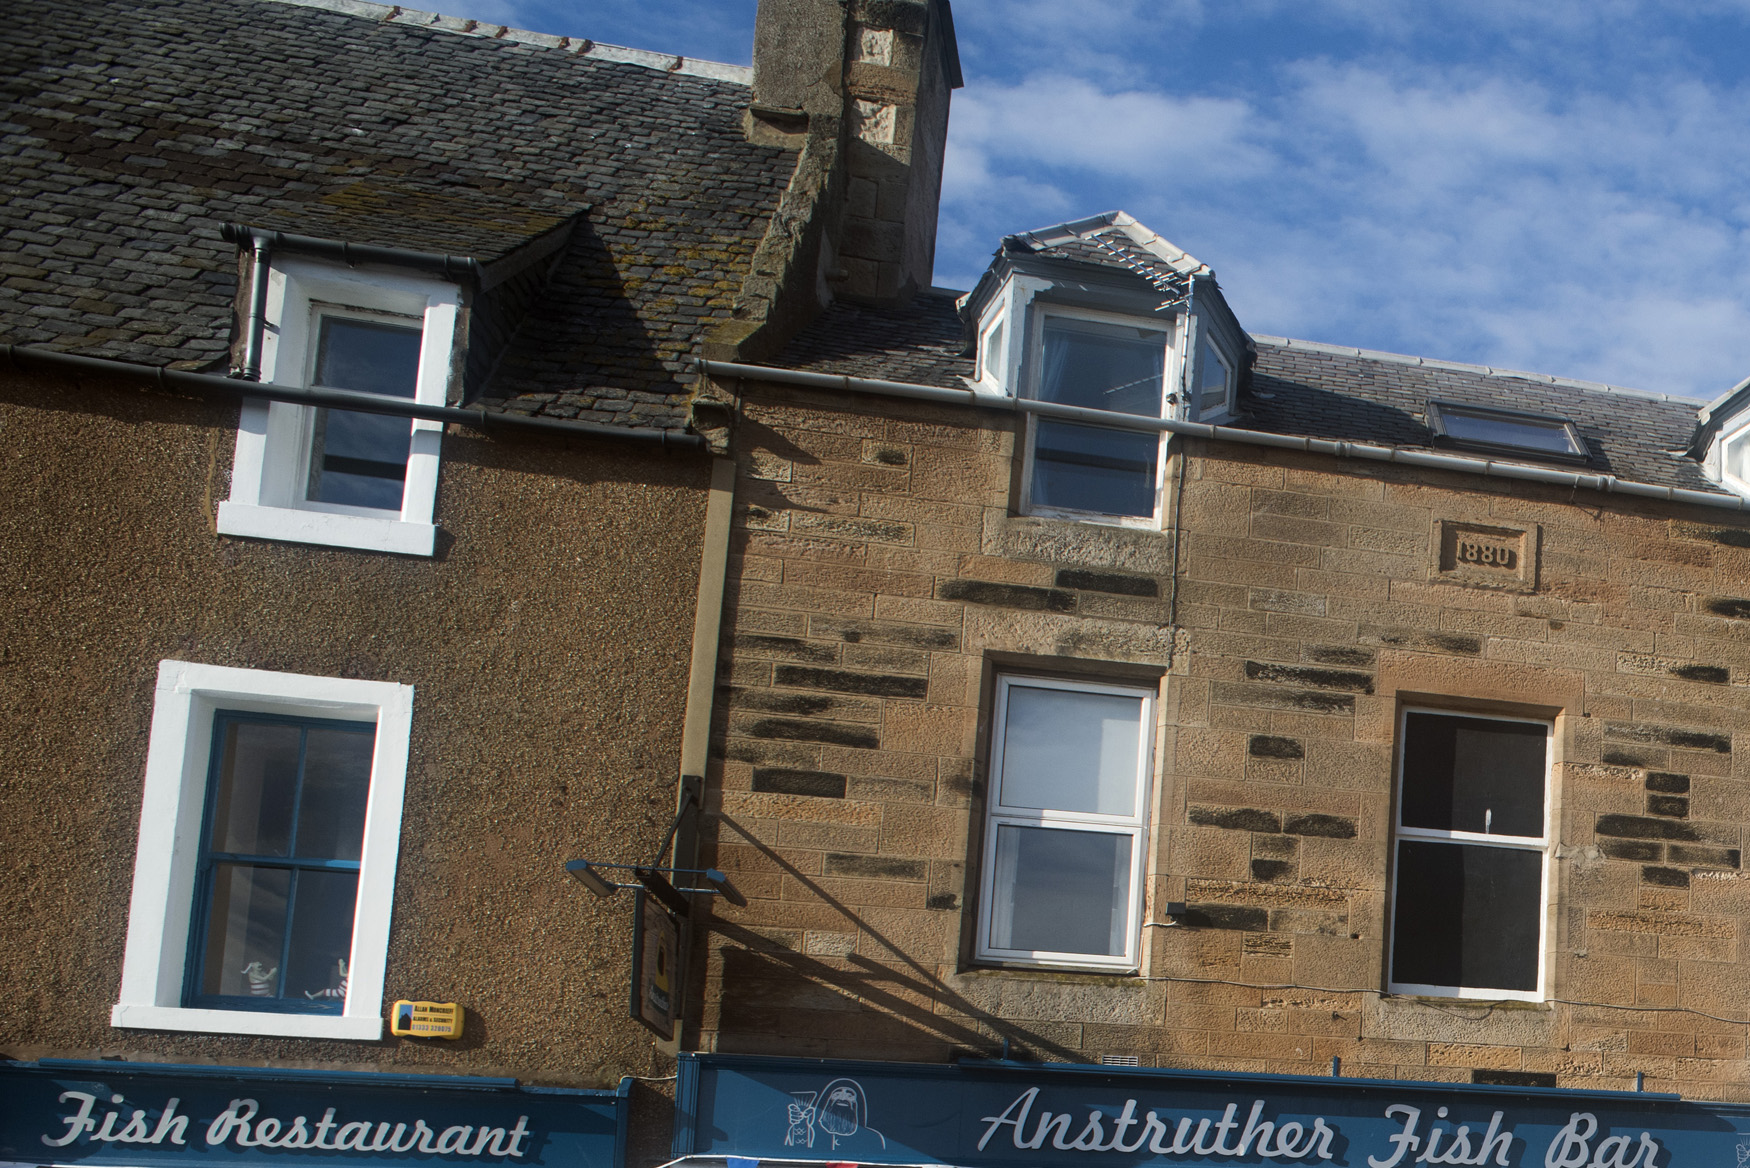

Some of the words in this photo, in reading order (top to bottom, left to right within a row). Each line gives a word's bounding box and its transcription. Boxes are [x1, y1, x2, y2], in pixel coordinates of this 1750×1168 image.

[1456, 539, 1509, 564] 1880
[41, 1091, 190, 1147] Fish
[206, 1098, 530, 1158] Restaurant
[977, 1086, 1334, 1159] Anstruther
